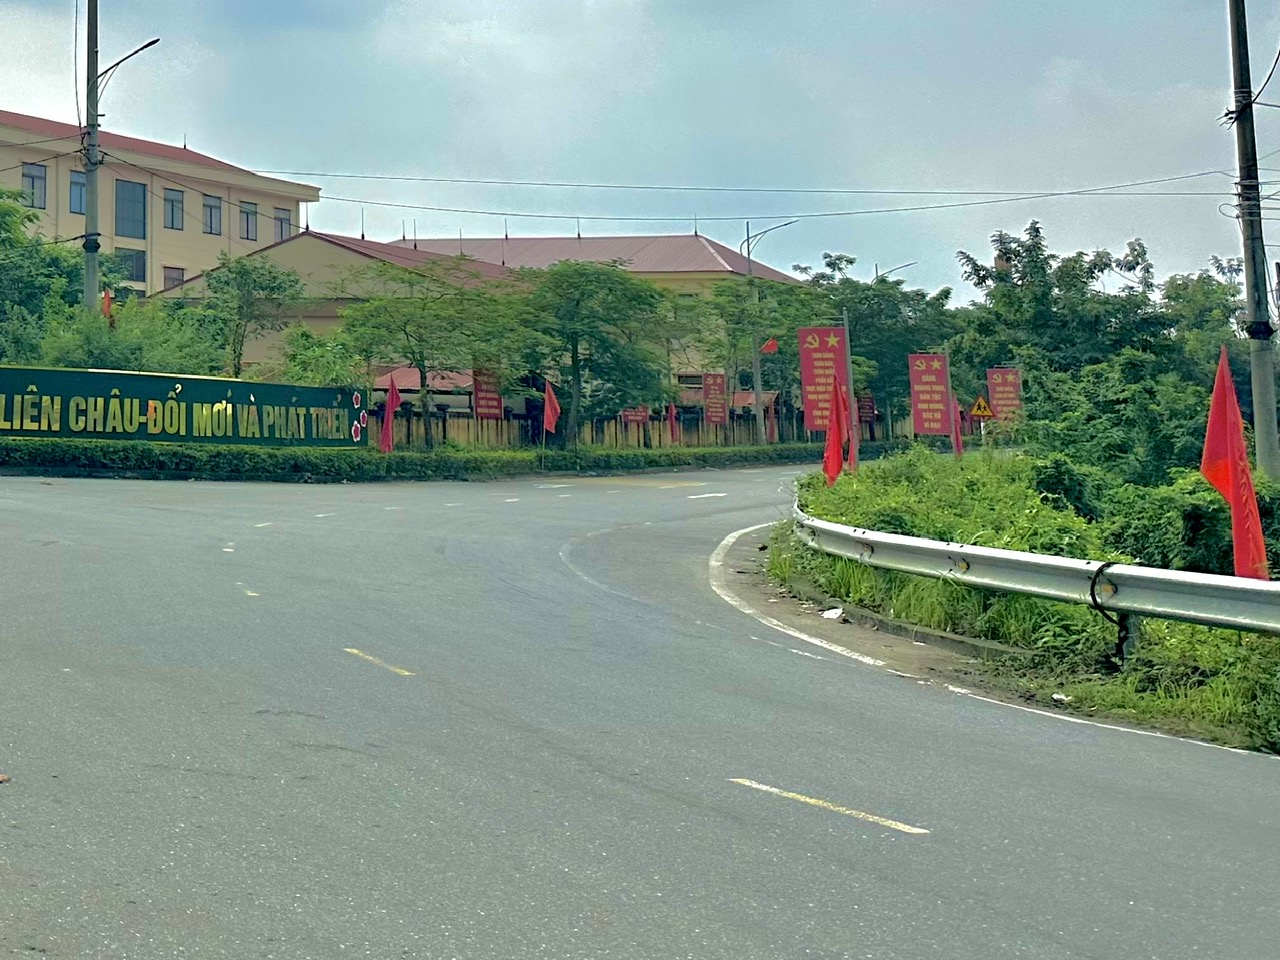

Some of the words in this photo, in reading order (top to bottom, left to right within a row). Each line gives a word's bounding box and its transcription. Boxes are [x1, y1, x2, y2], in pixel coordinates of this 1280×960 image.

[192, 389, 233, 437] MỚI
[236, 393, 261, 438] VÀ
[262, 395, 307, 439] PHÁT
[309, 393, 350, 440] TRIỂN
